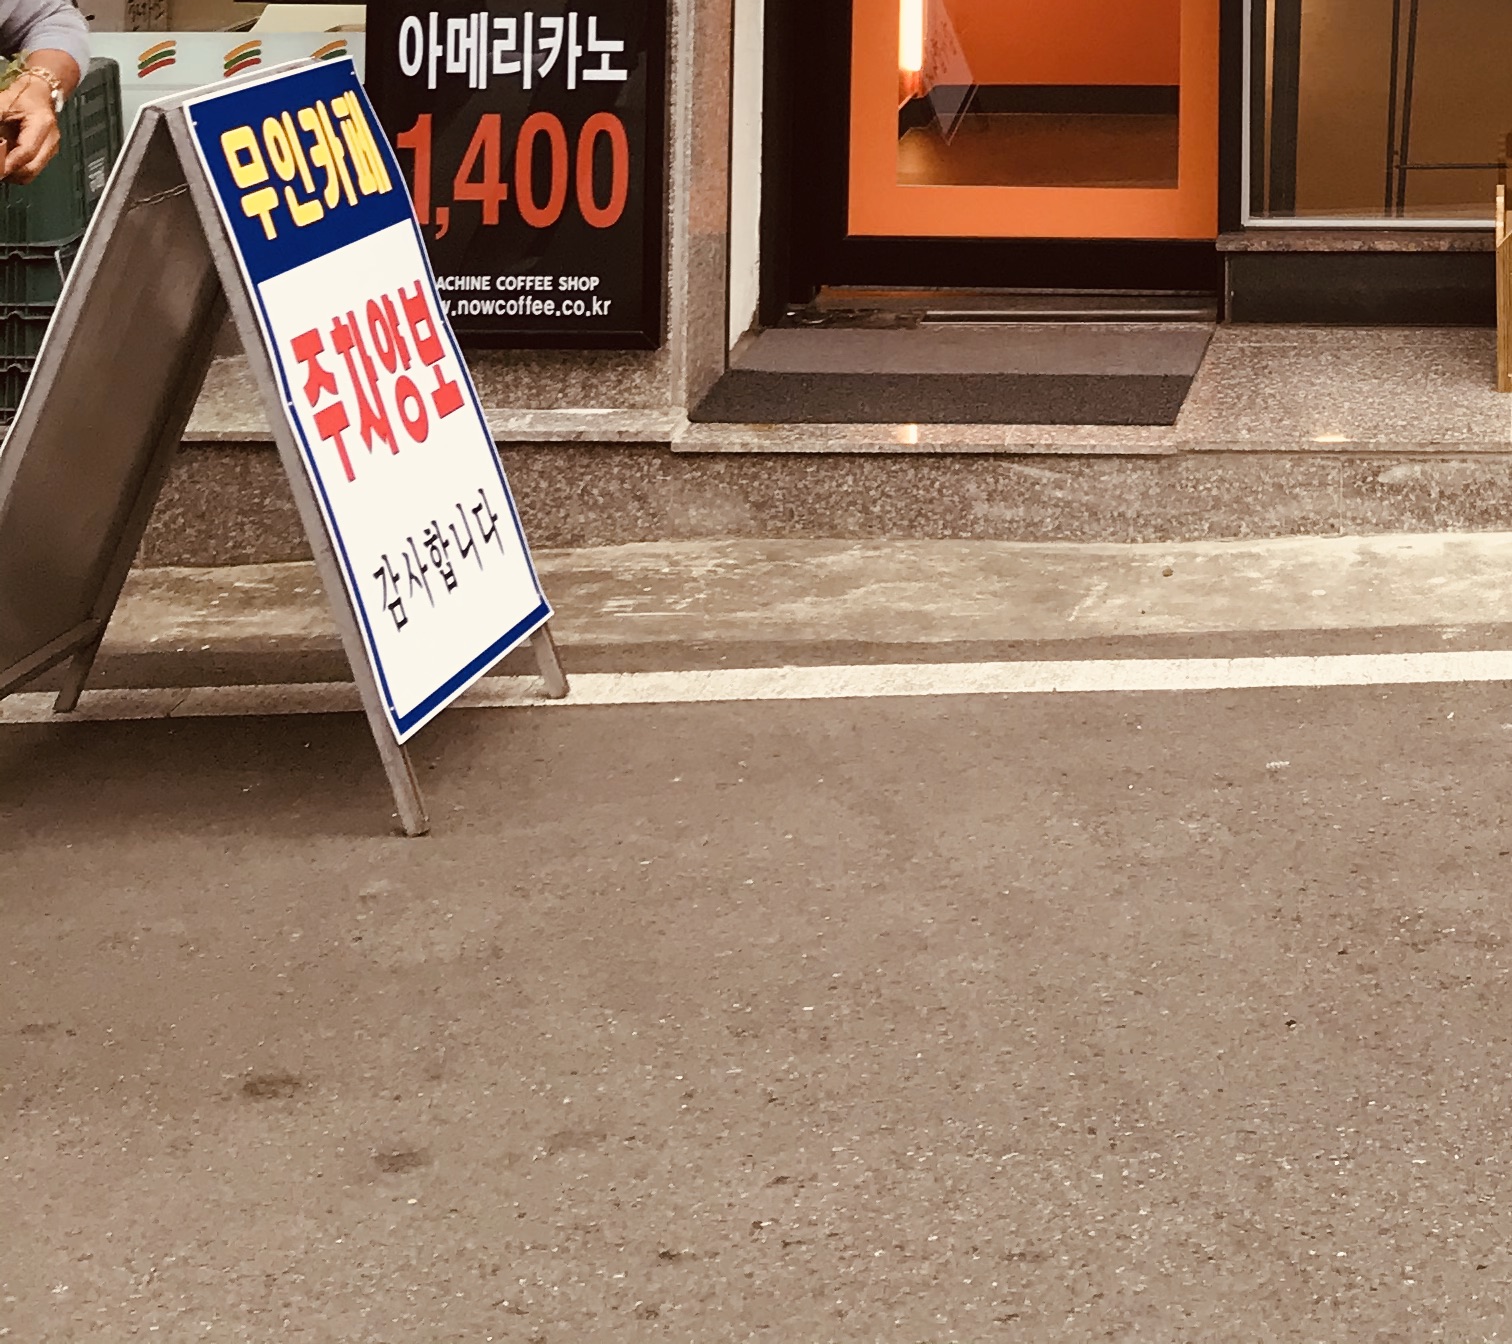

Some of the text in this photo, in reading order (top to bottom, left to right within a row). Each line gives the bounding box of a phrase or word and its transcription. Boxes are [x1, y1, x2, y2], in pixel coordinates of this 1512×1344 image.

[399, 11, 629, 90] 아메리카노
[219, 88, 391, 243] 무인카페
[396, 111, 631, 241] 1,400
[435, 275, 600, 292] ACHINE COFFEE SHOP
[290, 278, 467, 484] 주차양보
[373, 488, 502, 634] 감사합니다
